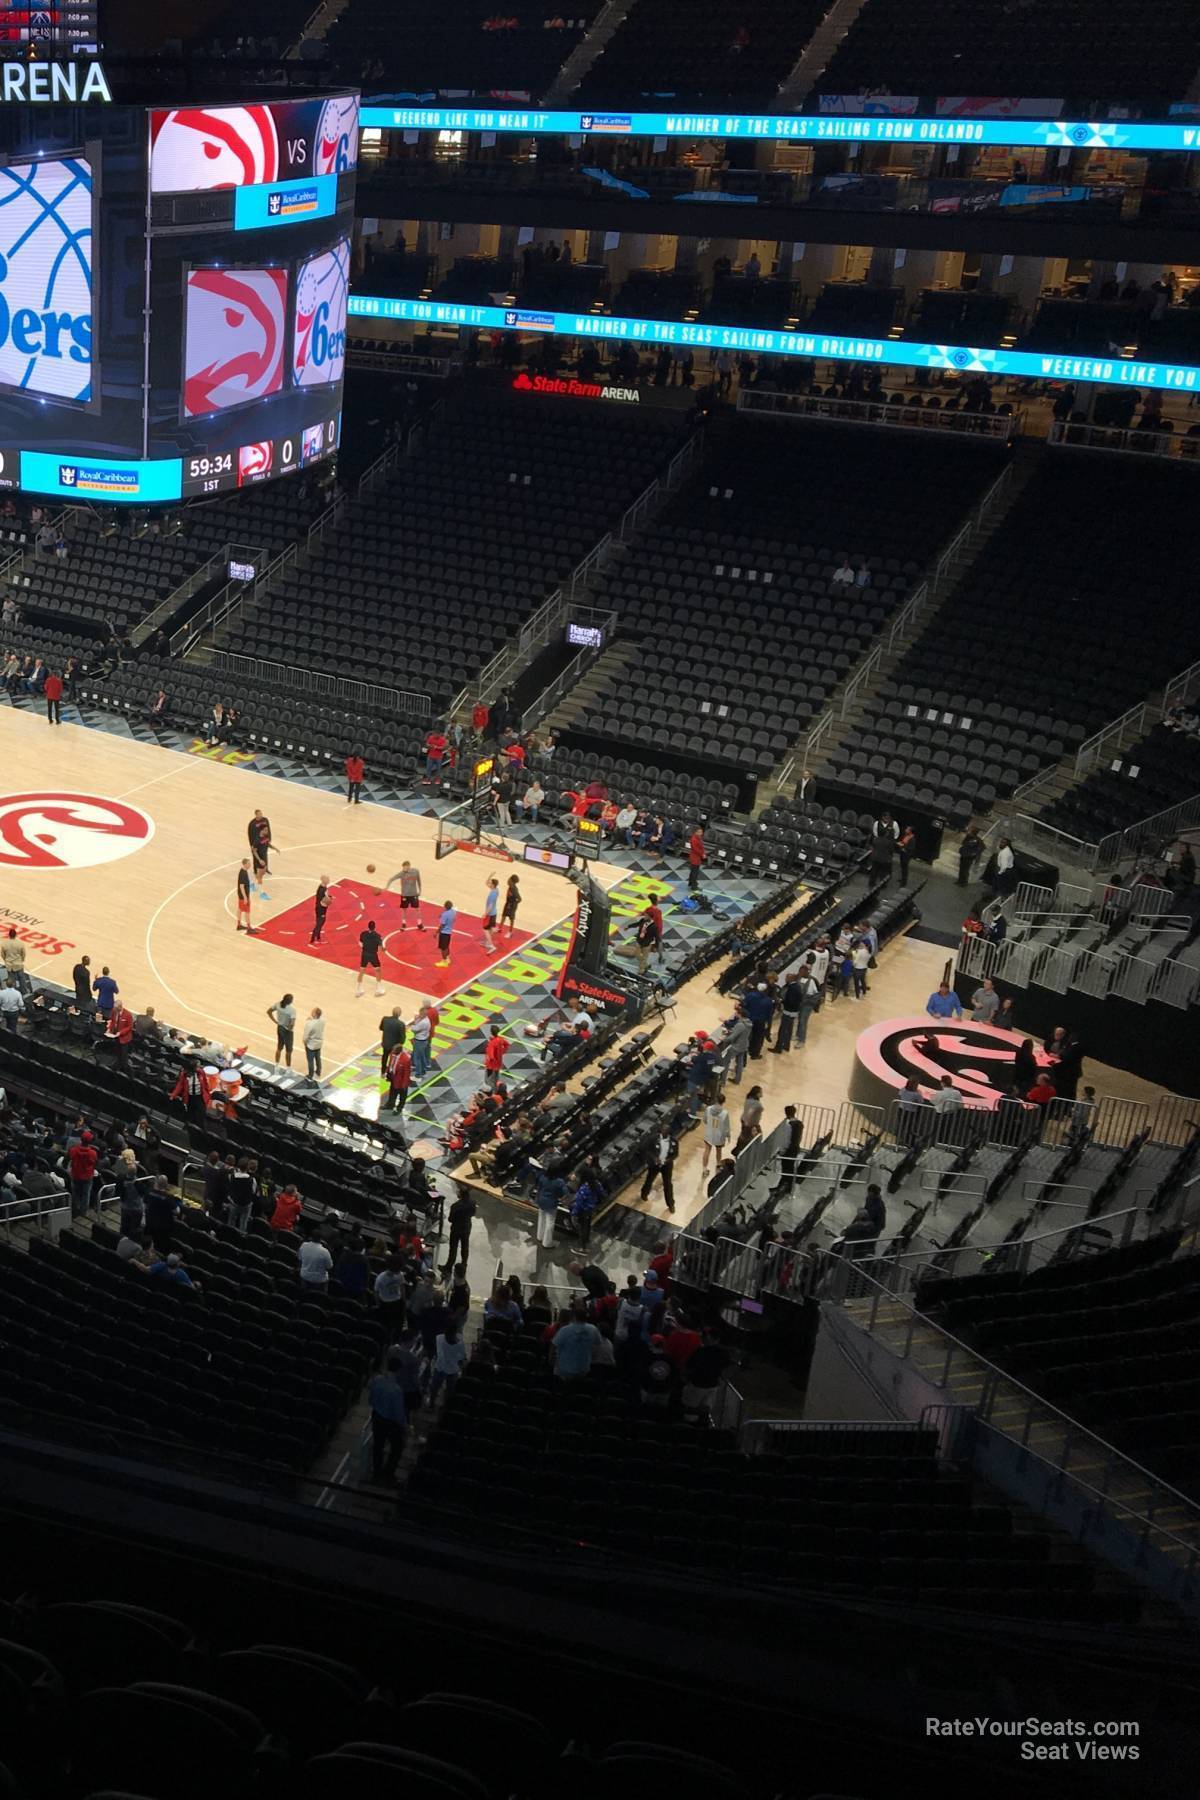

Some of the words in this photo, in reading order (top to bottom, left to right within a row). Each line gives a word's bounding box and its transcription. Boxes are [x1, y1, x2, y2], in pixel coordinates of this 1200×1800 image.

[393, 112, 440, 126] WEEKEND
[445, 112, 469, 126] LIKE
[474, 113, 494, 127] YOU
[500, 114, 529, 128] MEAN
[665, 117, 720, 133] MARINER
[725, 119, 740, 134] OF
[747, 119, 769, 135] THE
[817, 120, 870, 137] SAILING
[877, 122, 913, 138] FROM
[919, 122, 984, 140] ORLANDO
[287, 138, 306, 164] VS
[348, 299, 379, 315] EKEND
[384, 301, 406, 316] LIKE
[412, 303, 431, 318] YOU
[437, 305, 466, 321] MEAN
[575, 318, 627, 336] MARINER
[632, 322, 647, 338] OF
[654, 323, 676, 340] THE
[722, 330, 774, 348] SAILING
[780, 334, 815, 353] FROM
[821, 339, 884, 359] ORLANDO
[1041, 358, 1113, 379] WEEKEND
[1121, 365, 1156, 383] LIKE
[1166, 369, 1196, 387] YOU
[601, 386, 640, 402] ARENA
[328, 420, 335, 443] 0
[282, 440, 293, 464] 0
[79, 469, 137, 483] RoyalCaribbean
[190, 453, 232, 477] 59:34
[203, 479, 220, 492] 1ST
[576, 898, 592, 938] xfinity
